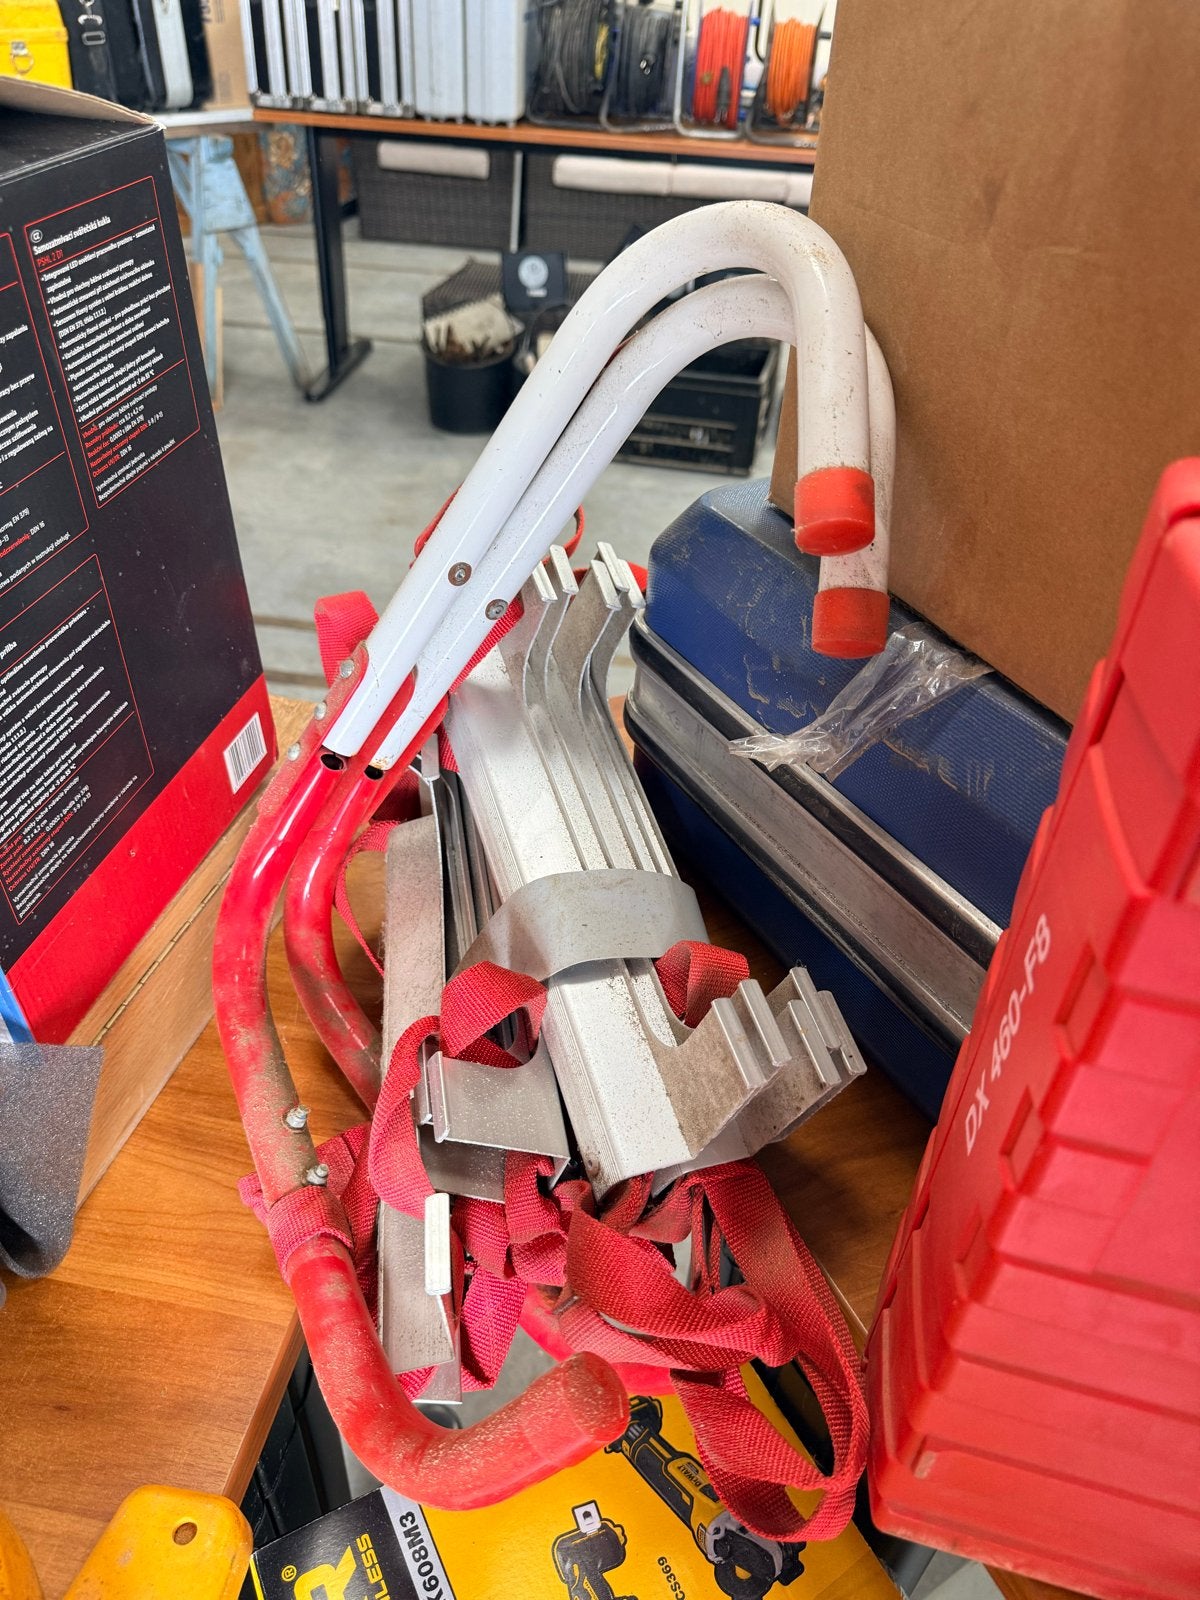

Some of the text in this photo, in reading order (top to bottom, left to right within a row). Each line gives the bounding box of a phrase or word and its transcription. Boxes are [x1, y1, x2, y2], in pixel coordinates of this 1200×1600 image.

[96, 216, 111, 227] kukla
[69, 260, 78, 269] LED
[65, 288, 74, 297] pro
[9, 382, 19, 391] bez
[30, 525, 40, 535] DIN
[0, 641, 17, 659] prilba
[965, 913, 1051, 1156] DX 460-F8
